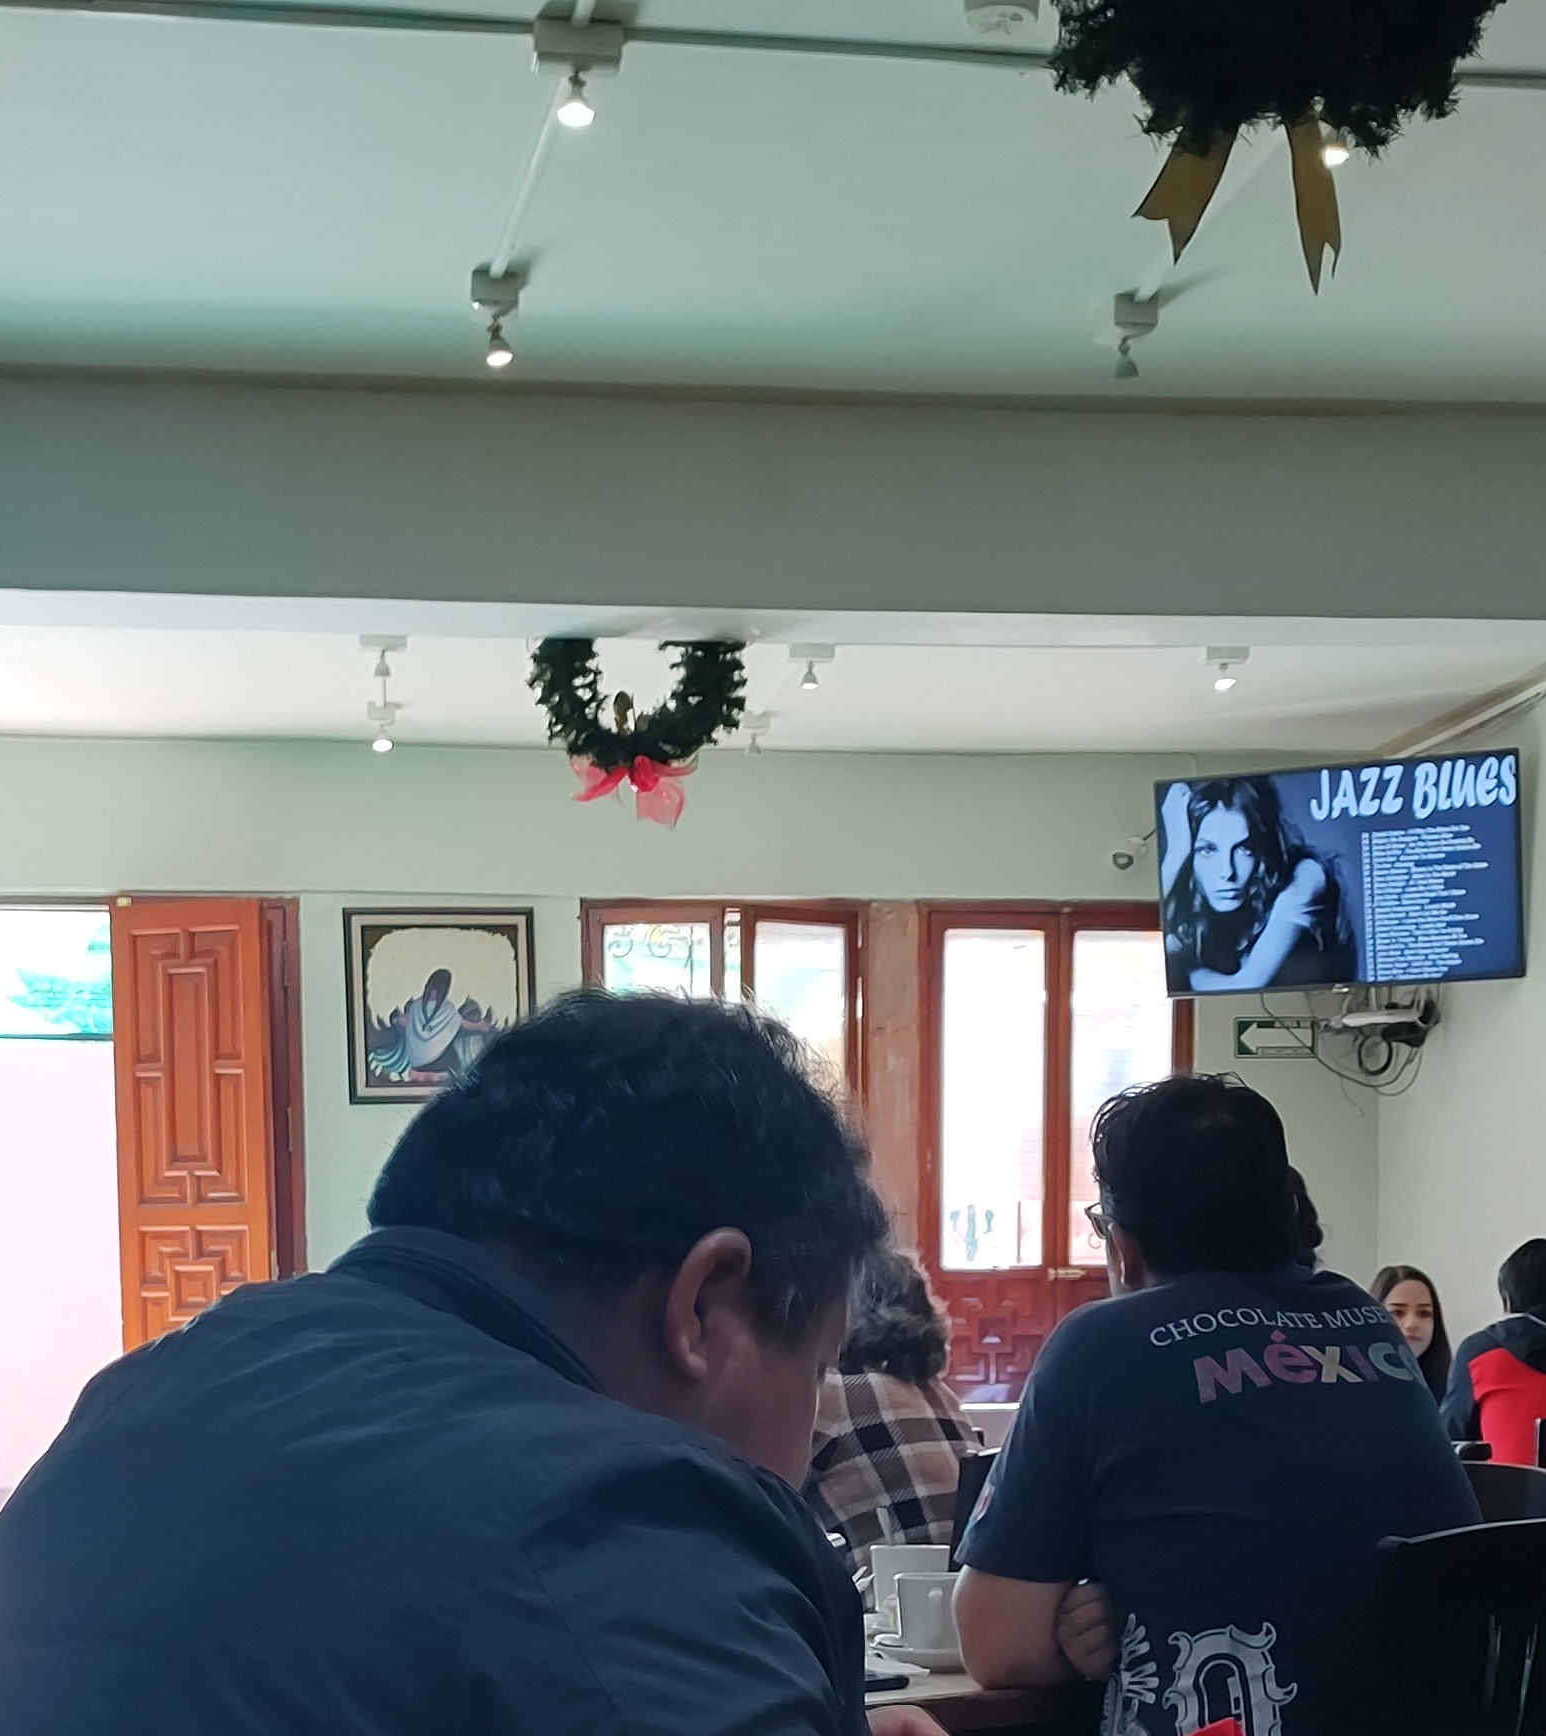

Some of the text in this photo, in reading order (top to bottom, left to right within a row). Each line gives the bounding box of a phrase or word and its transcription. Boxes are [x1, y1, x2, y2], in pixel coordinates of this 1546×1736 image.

[1310, 754, 1517, 822] JAZZ BLUES
[1149, 1306, 1323, 1348] CHOCOLATE
